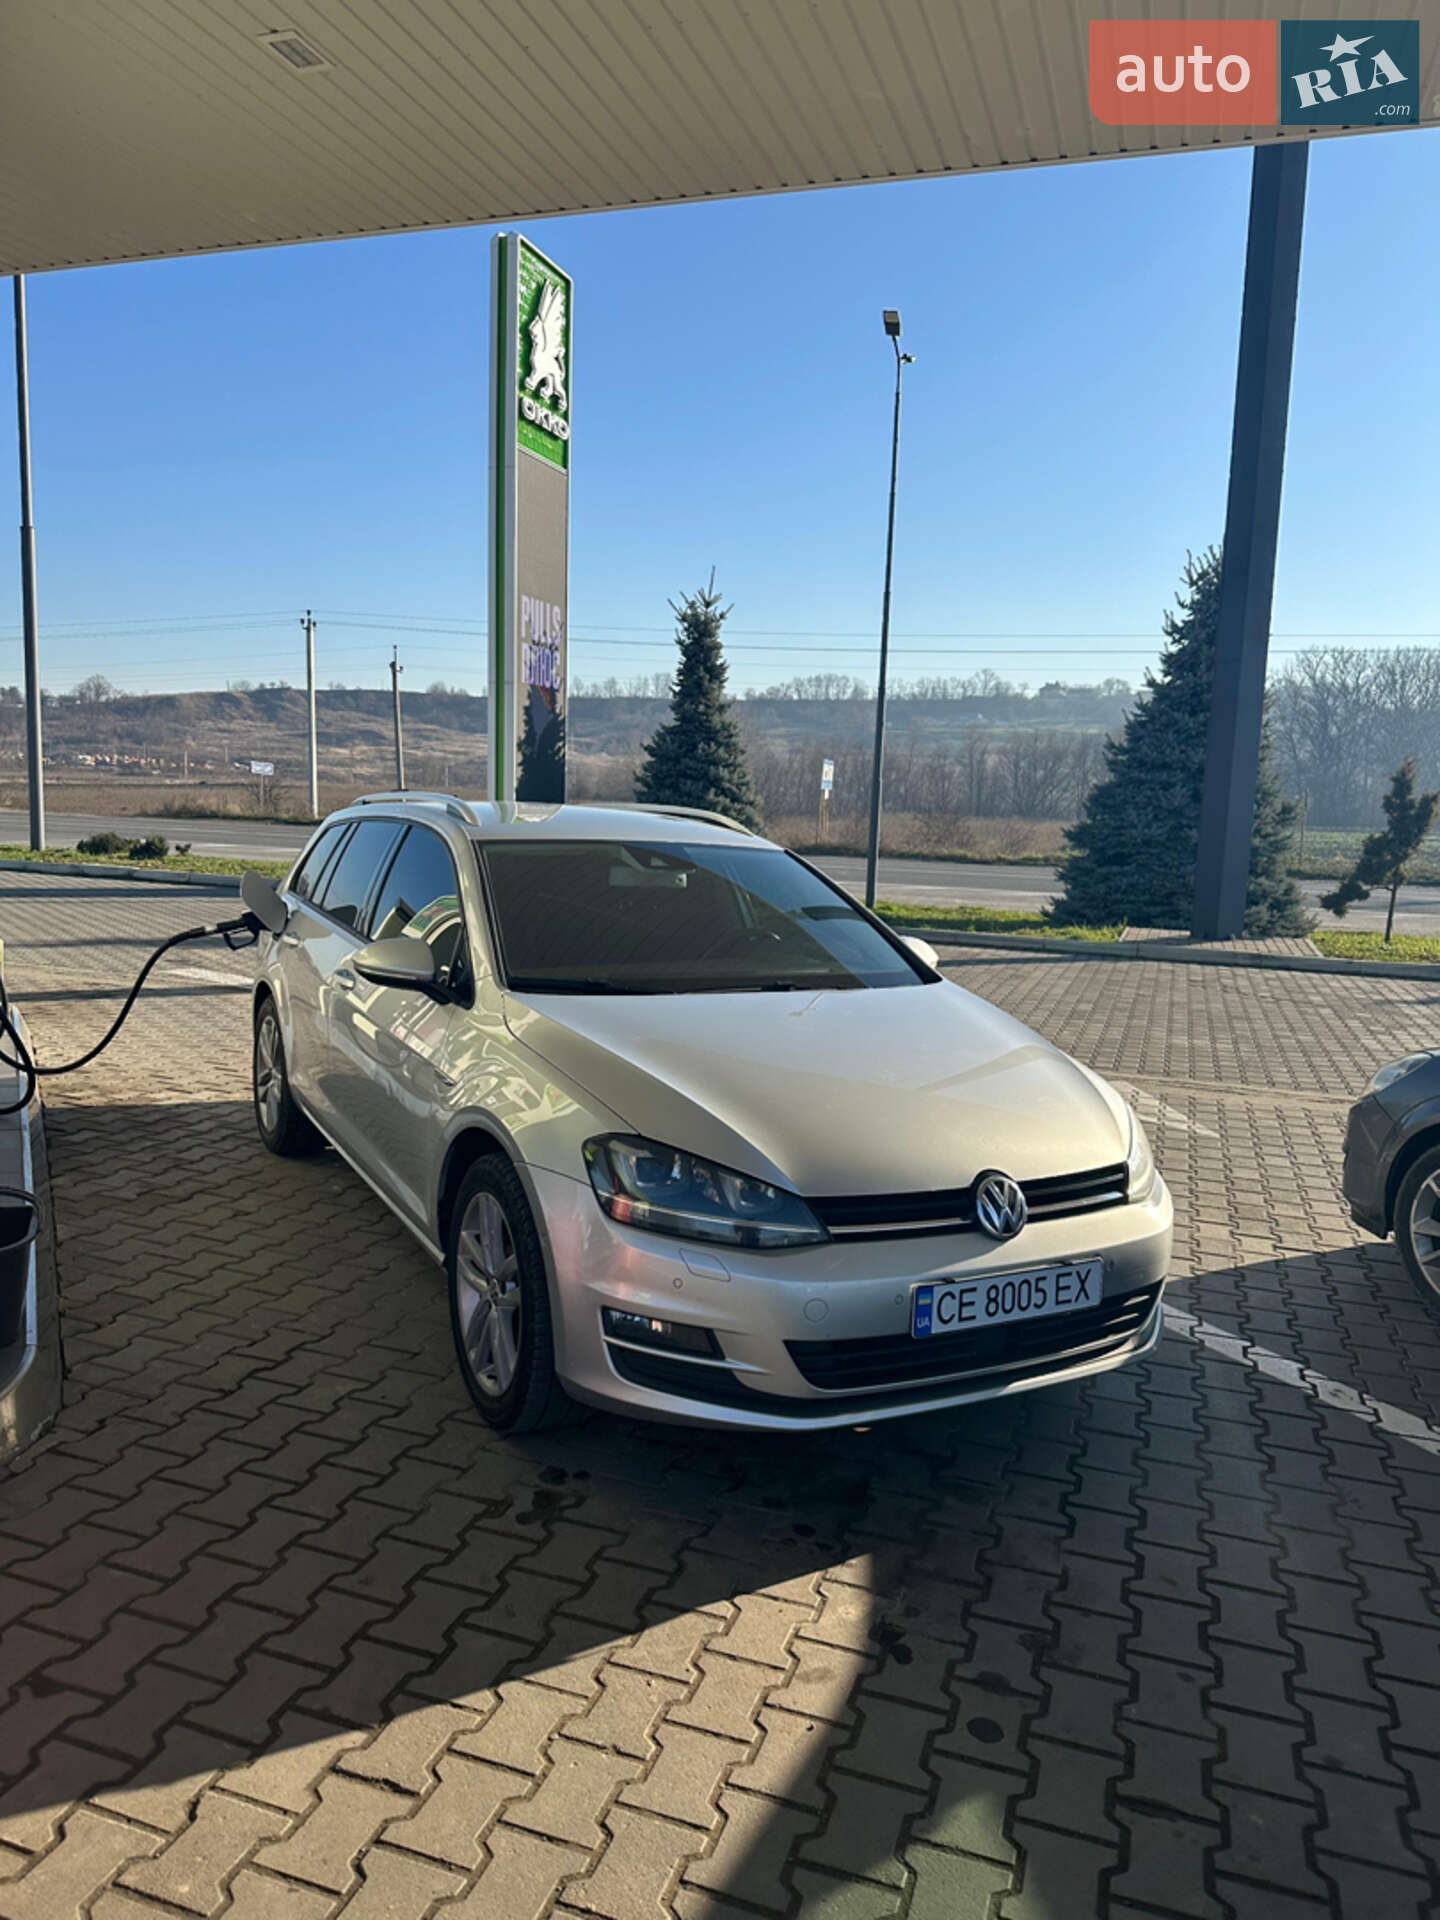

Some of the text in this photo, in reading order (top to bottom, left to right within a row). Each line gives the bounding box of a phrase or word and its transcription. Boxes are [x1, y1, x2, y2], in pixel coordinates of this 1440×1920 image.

[521, 396, 569, 440] OKKO
[521, 594, 561, 647] PULLS
[936, 1268, 1092, 1325] CE 8005 EX
[916, 1317, 930, 1329] UA
